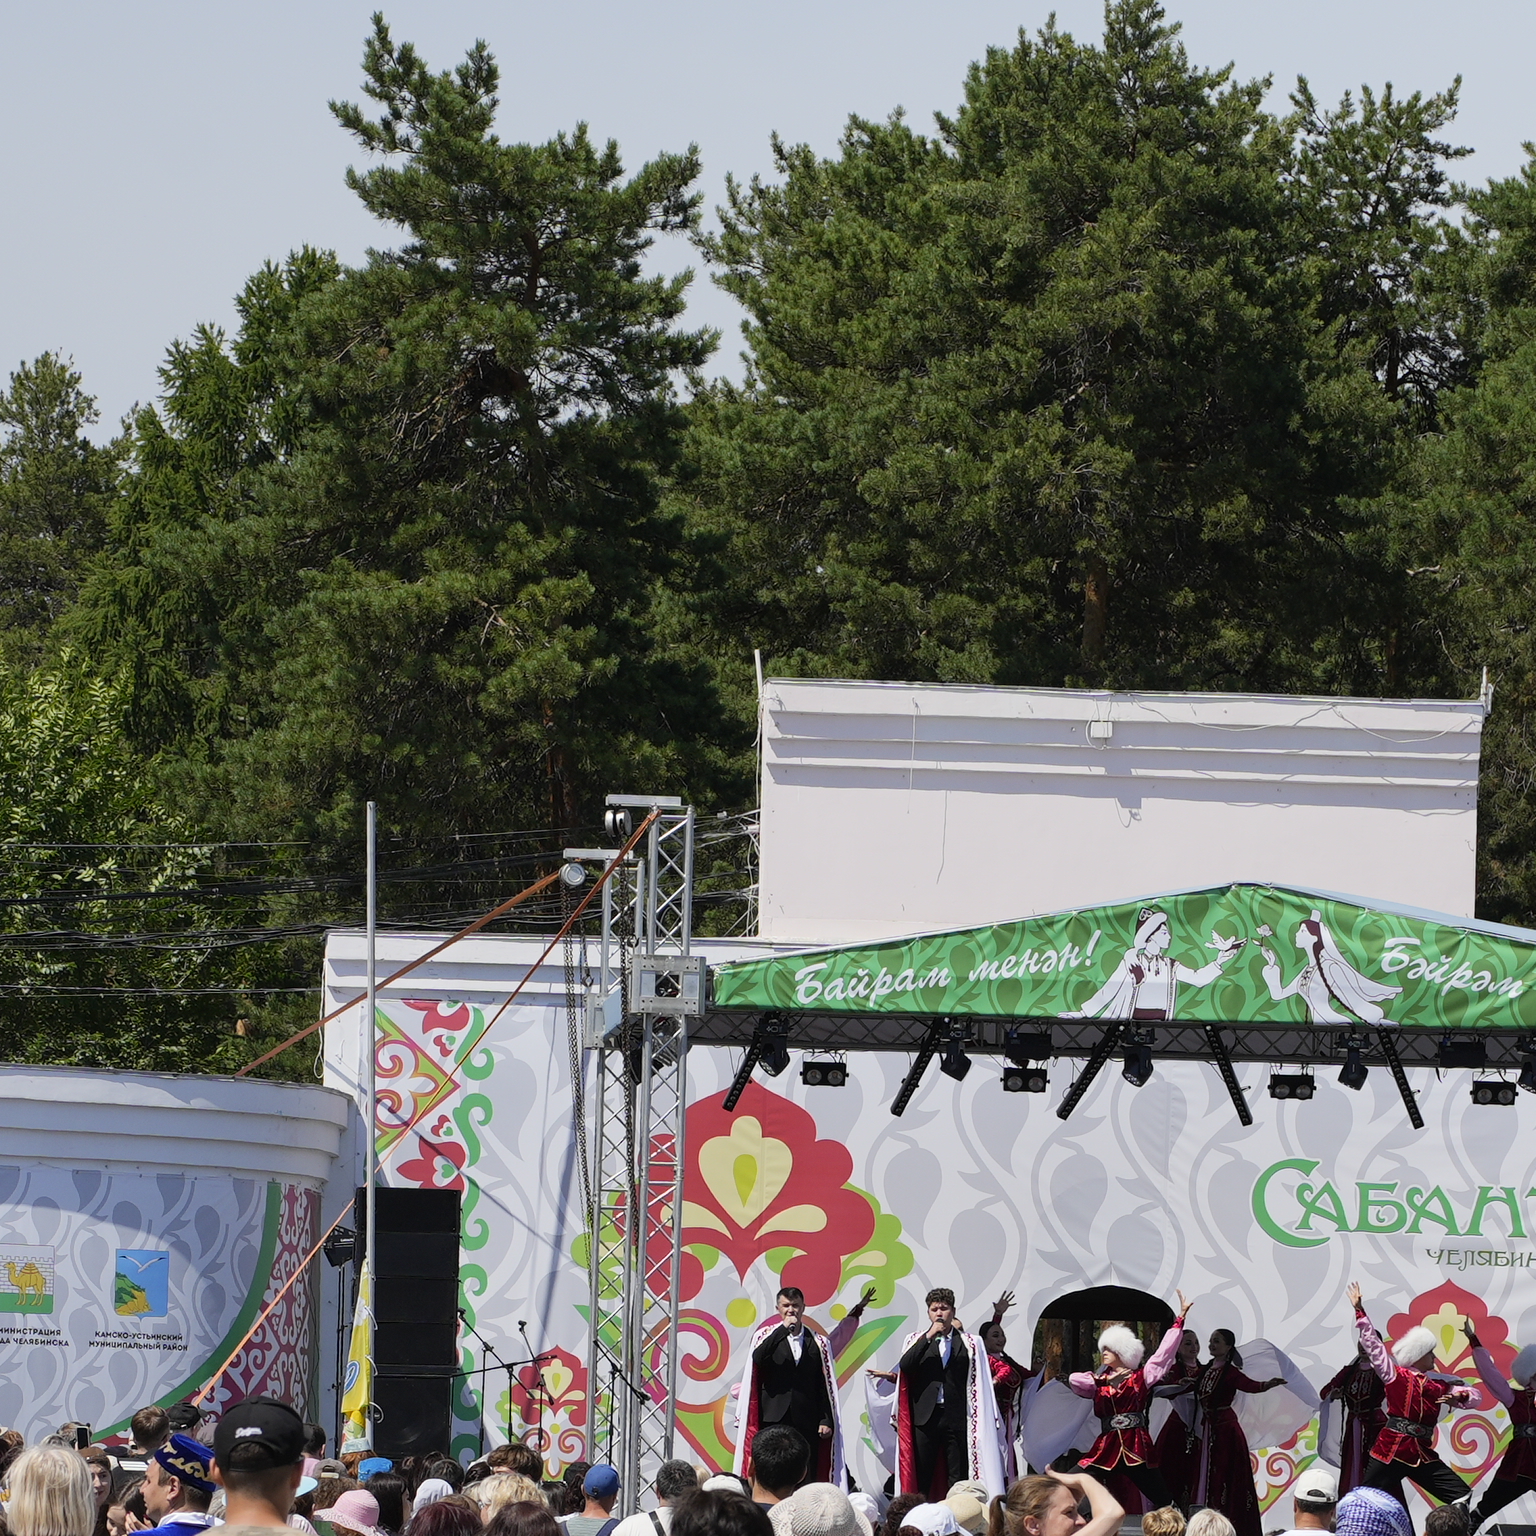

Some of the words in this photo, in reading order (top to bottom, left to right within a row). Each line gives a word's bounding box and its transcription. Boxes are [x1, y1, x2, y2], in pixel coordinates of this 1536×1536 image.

[794, 962, 952, 1007] Байрам
[968, 929, 1102, 981] менән!
[1381, 937, 1524, 999] Бәйрәм
[94, 1330, 183, 1341] КАМСКО-УСТЬИНСКИЙ
[13, 1337, 70, 1347] ЧЕЛЯБИНСКА
[88, 1340, 161, 1351] МУНИЦИПАЛЬНЫЙ
[162, 1342, 188, 1351] РАЙОН
